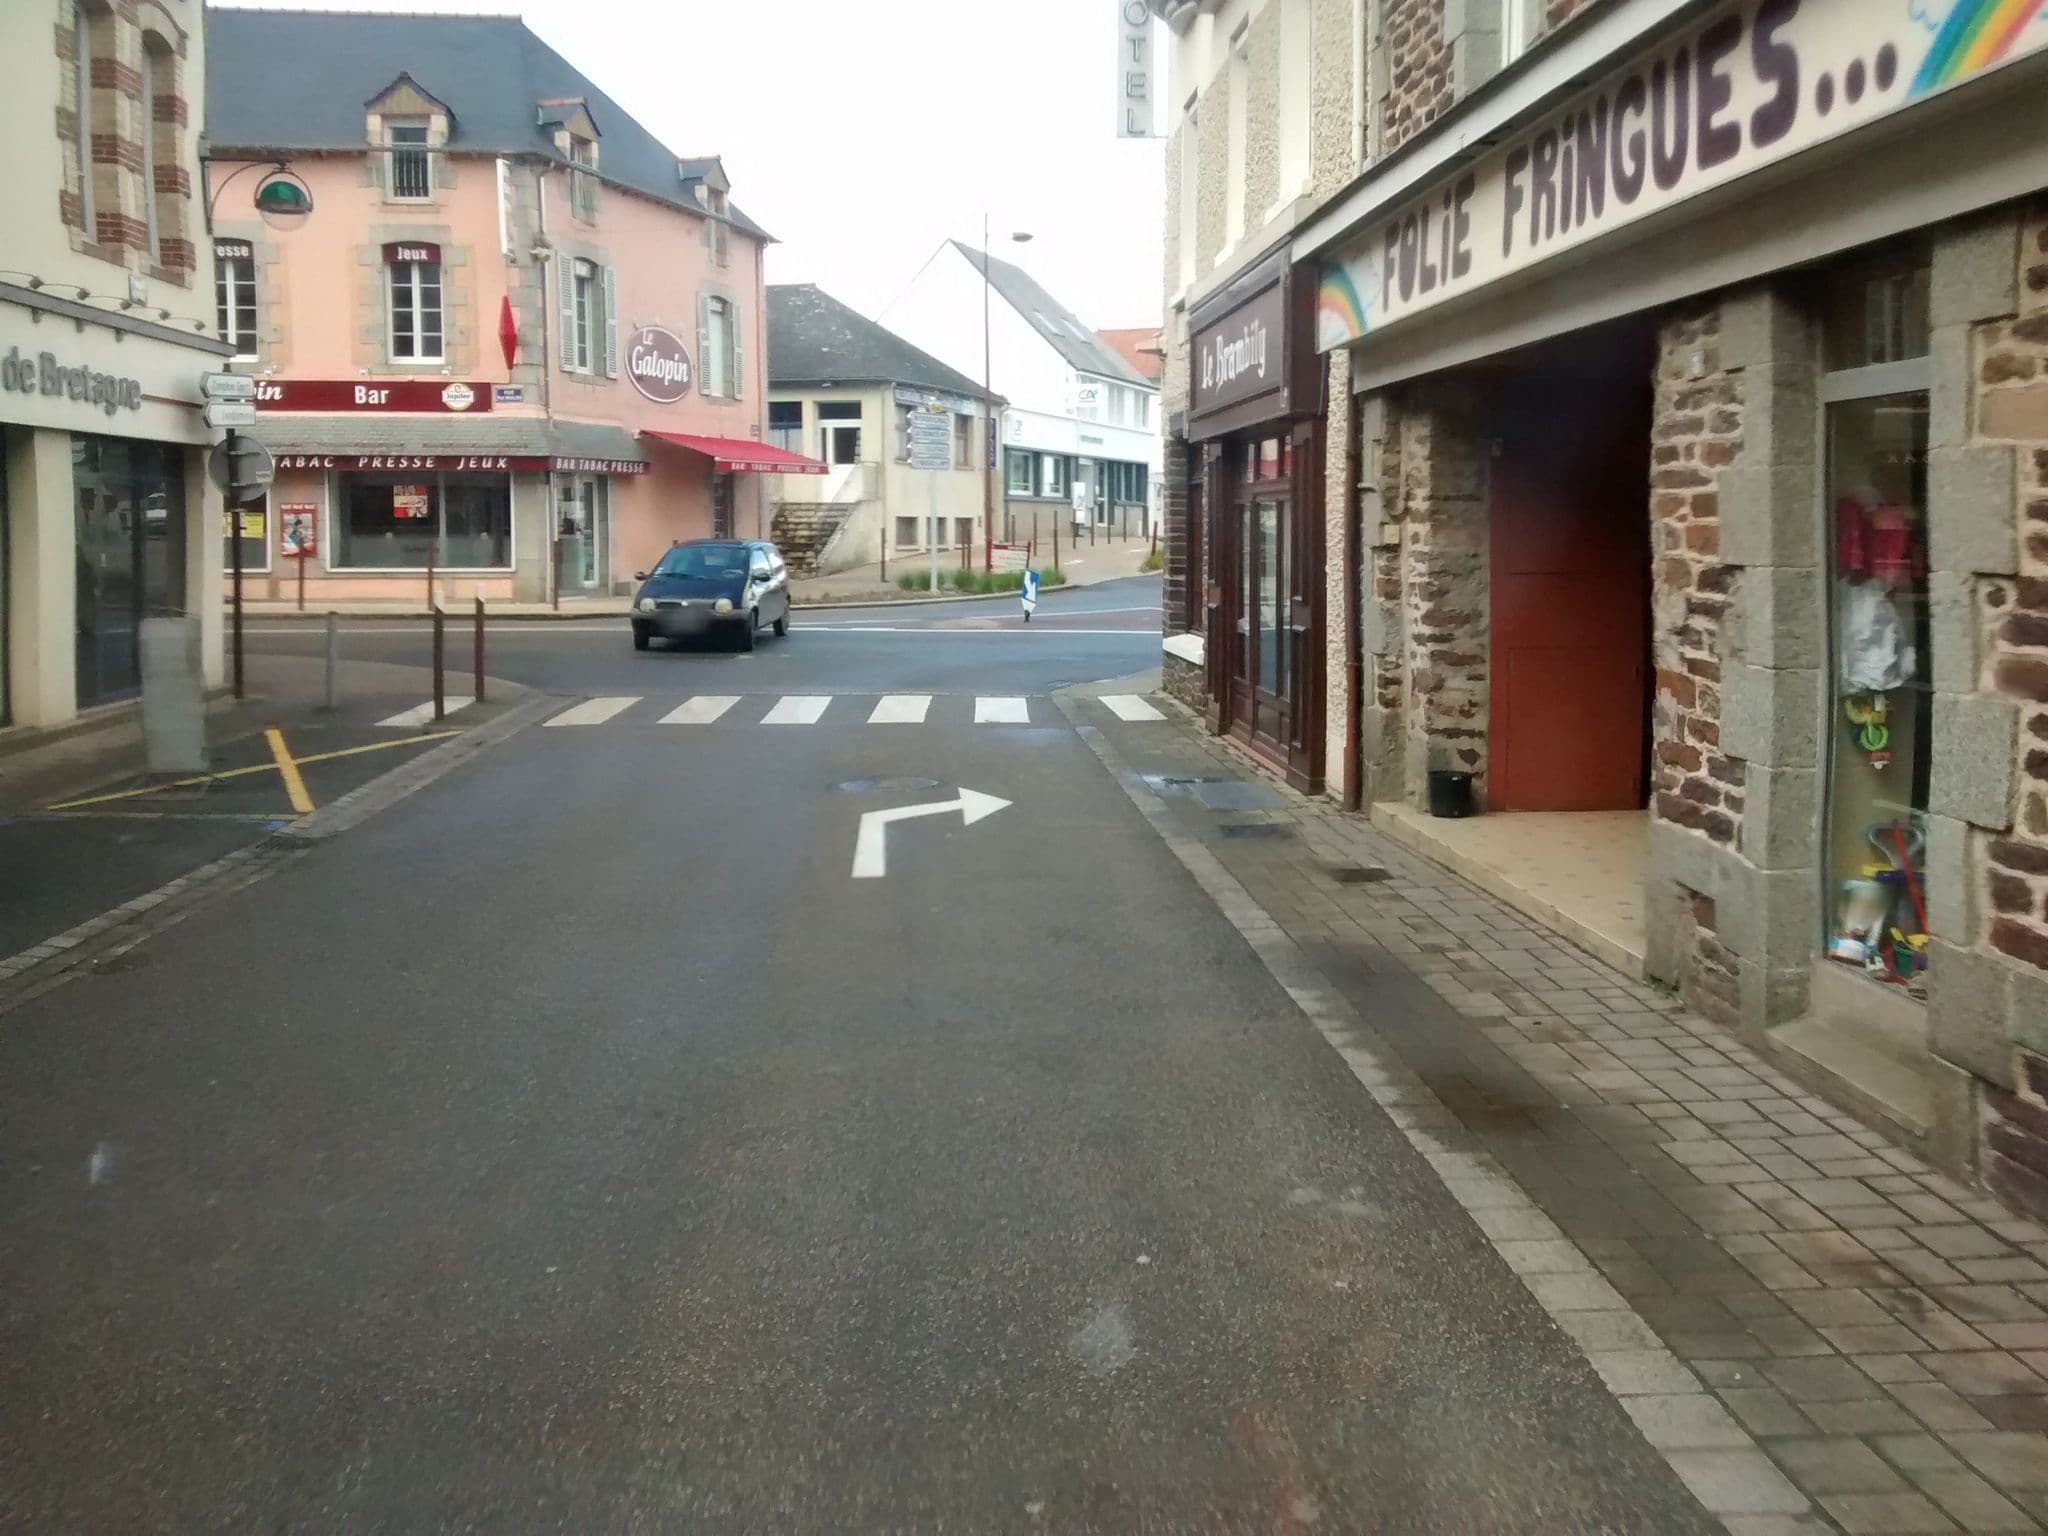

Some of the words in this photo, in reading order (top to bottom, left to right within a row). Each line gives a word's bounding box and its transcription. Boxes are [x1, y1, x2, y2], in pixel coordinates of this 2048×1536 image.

[215, 244, 249, 257] esse
[397, 247, 428, 260] Jeux
[643, 328, 653, 345] Le
[632, 345, 688, 386] Galopin
[2, 346, 36, 393] de
[39, 351, 141, 416] Bretagne
[253, 381, 283, 400] in
[354, 386, 389, 404] Bar
[359, 457, 435, 468] PRESSE
[457, 457, 508, 469] JEUX
[556, 458, 575, 470] BAR
[580, 459, 609, 472] TABAC
[611, 461, 645, 473] PRESSE
